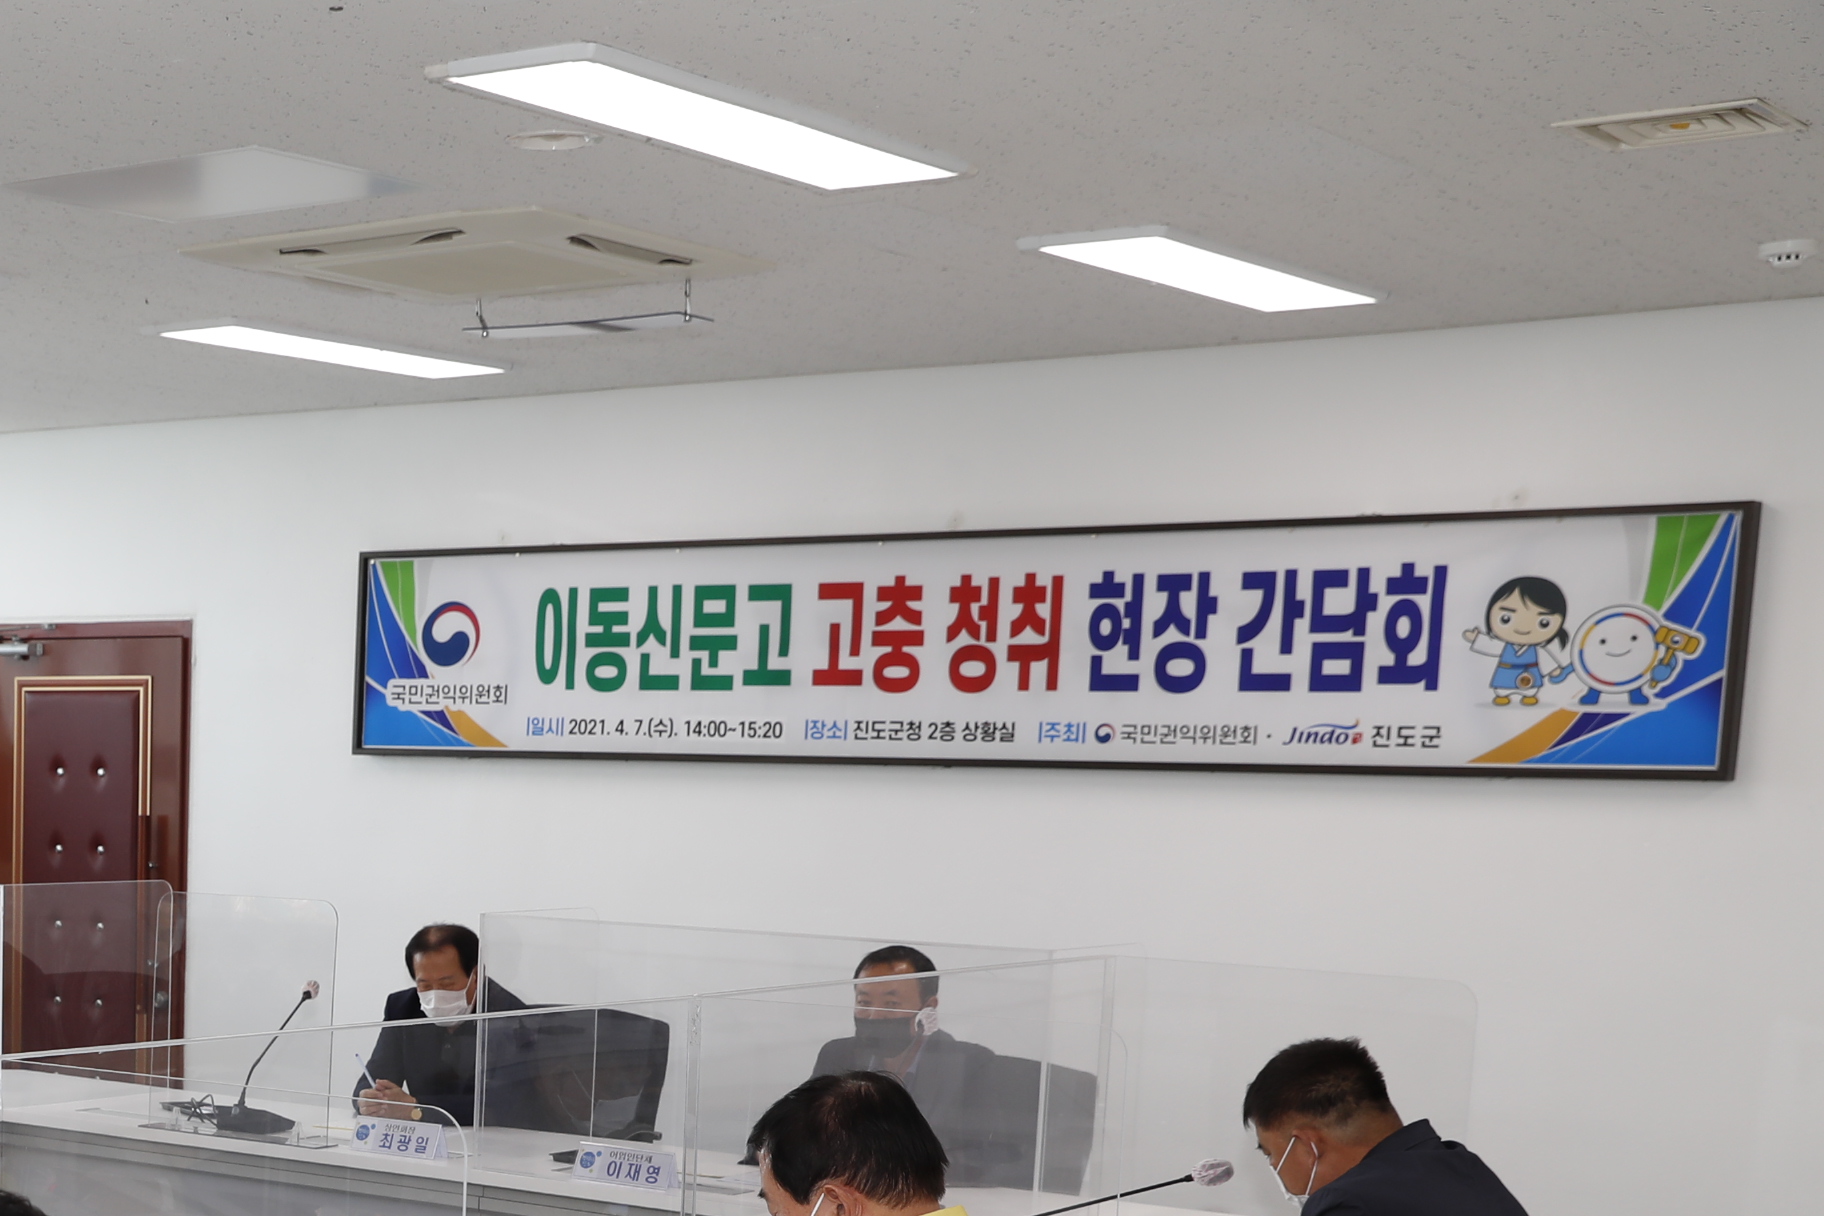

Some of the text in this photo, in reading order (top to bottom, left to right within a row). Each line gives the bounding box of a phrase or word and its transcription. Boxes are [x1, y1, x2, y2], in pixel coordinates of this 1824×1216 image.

[535, 562, 1448, 694] 이동신문고 고충 청취 현장 간담회
[391, 684, 508, 705] 국민권익위원회
[568, 718, 610, 736] 2021.
[615, 719, 628, 736] 4.
[684, 720, 783, 739] 14:00~15:20
[853, 720, 922, 741] 진도군청
[928, 721, 956, 742] 2층
[961, 721, 1016, 743] 상황실
[1120, 724, 1259, 746] 국민권익위원회
[1370, 725, 1443, 749] 진도군
[378, 1132, 429, 1154] 최광일
[609, 1150, 653, 1164] 어업인단체
[606, 1160, 661, 1184] 이재영
